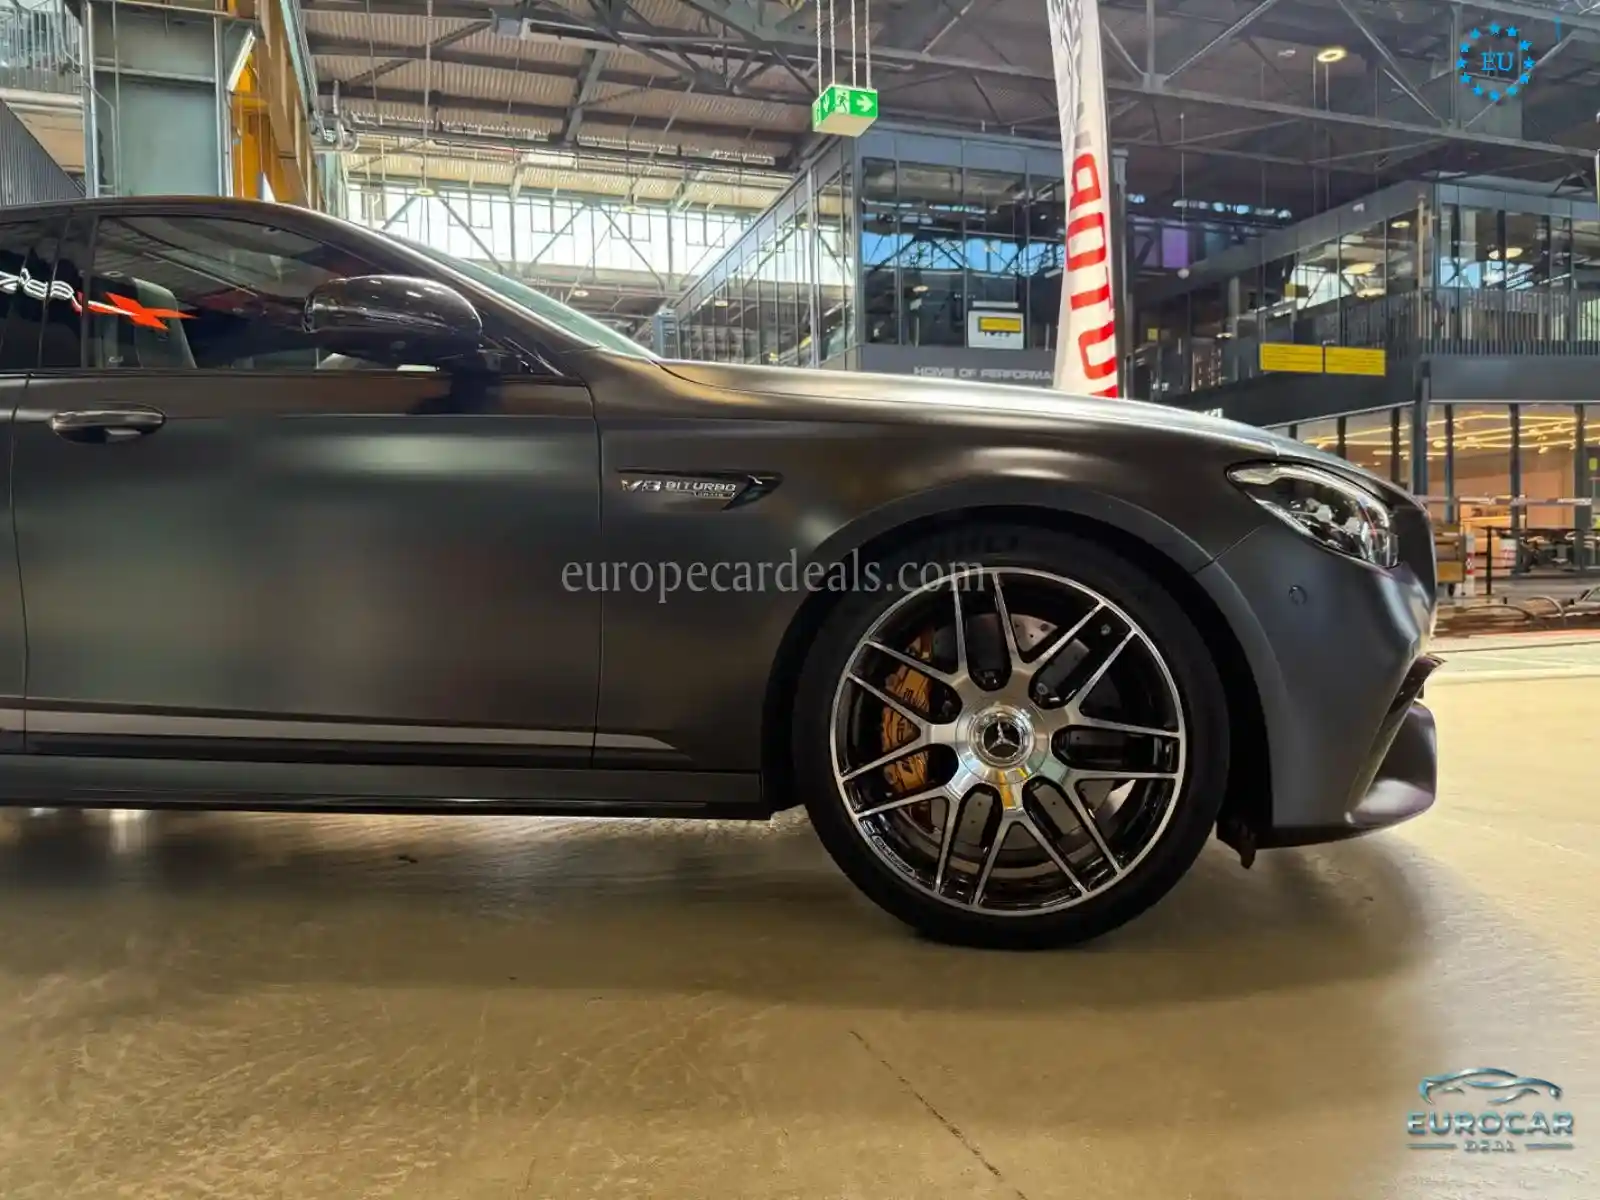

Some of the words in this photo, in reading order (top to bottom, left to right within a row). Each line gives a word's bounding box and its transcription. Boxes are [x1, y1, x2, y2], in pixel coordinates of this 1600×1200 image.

[914, 366, 954, 377] HOME
[959, 368, 976, 378] OF
[620, 479, 661, 492] V8
[664, 481, 737, 492] BITURBO
